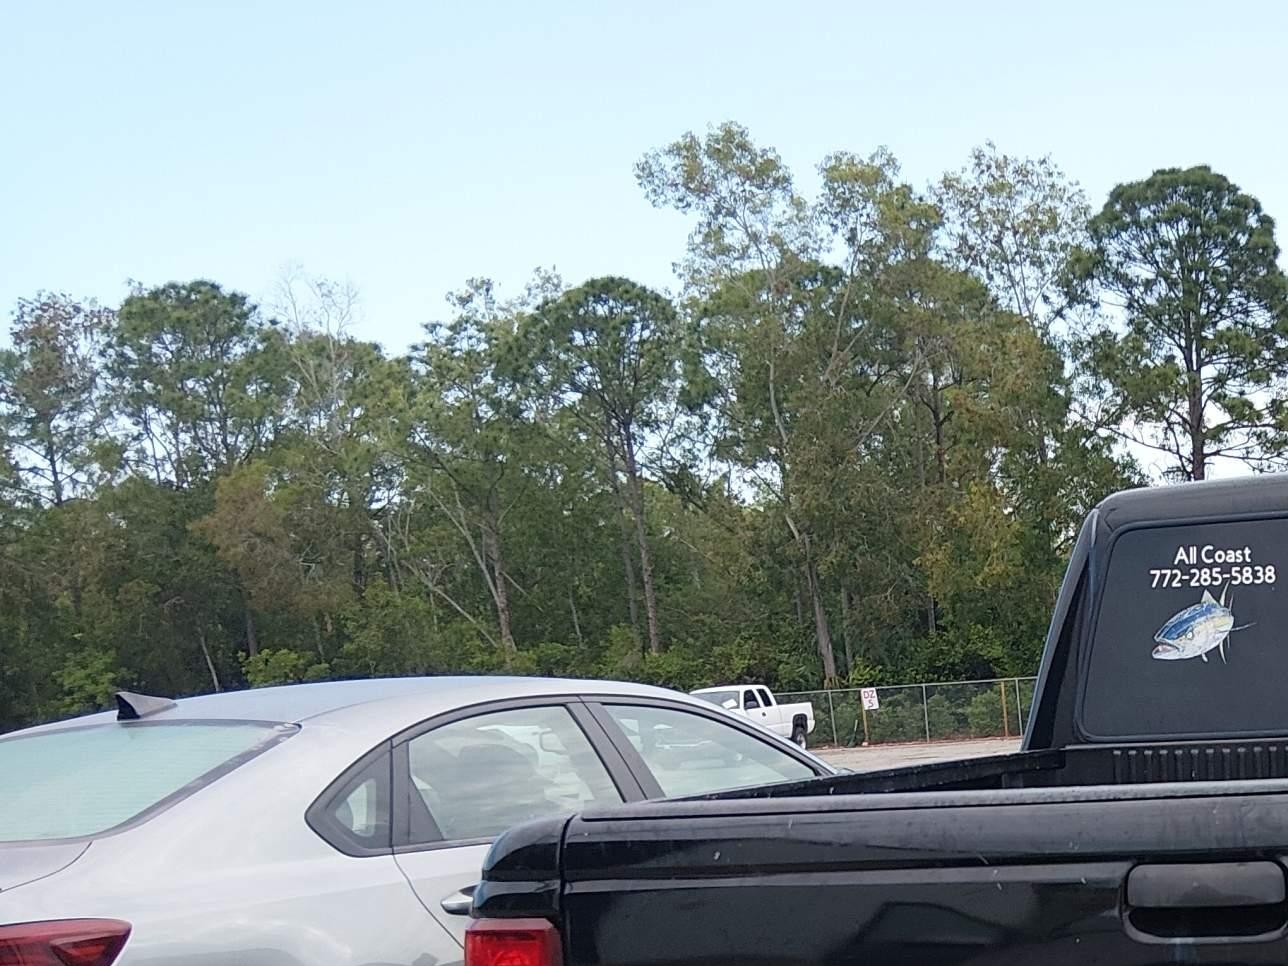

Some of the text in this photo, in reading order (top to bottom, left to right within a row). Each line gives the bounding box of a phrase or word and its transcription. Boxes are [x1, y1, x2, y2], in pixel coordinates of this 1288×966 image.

[1174, 545, 1252, 565] All Coast
[1150, 565, 1276, 588] 772-285-5838
